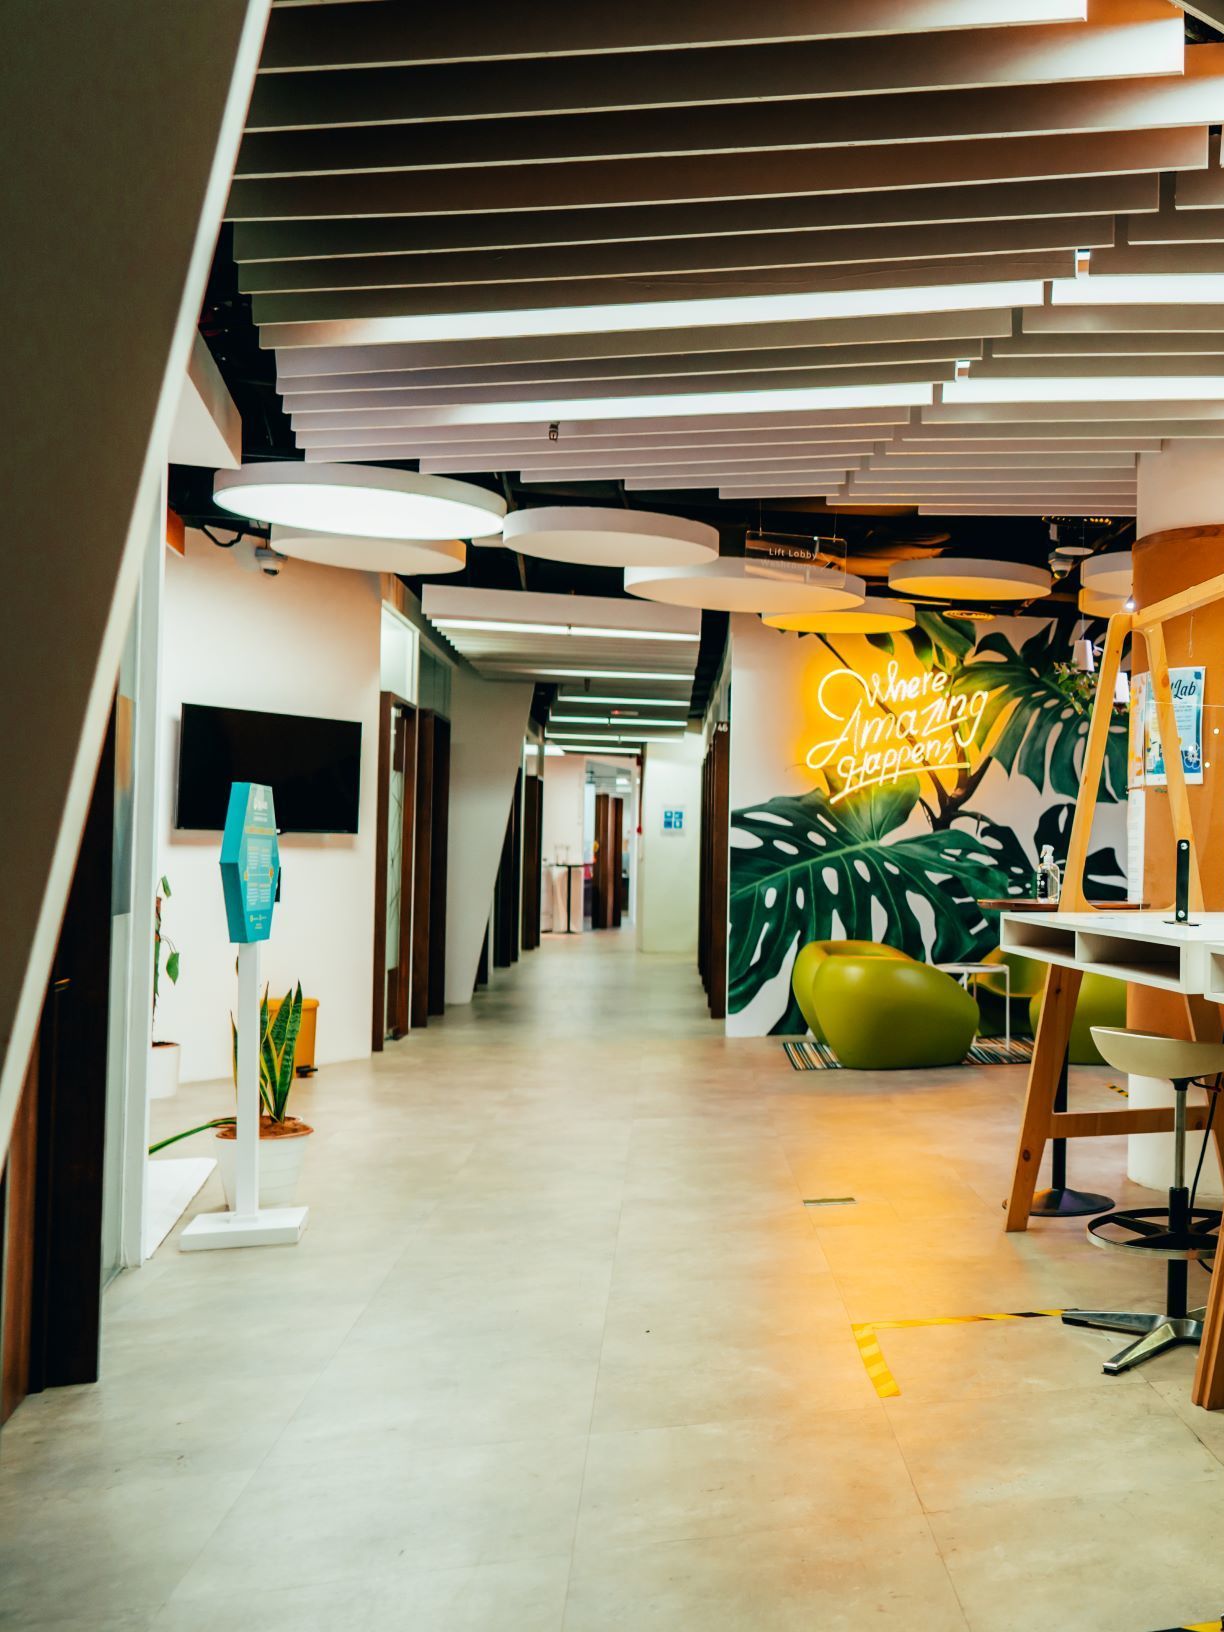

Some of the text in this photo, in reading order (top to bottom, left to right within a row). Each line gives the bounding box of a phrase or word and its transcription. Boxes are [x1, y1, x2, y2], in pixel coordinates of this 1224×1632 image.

[769, 547, 817, 561] Lift Lobby
[818, 660, 948, 721] Where
[1170, 679, 1196, 700] Lab
[806, 690, 989, 769] Amazing
[837, 736, 955, 791] Happens
